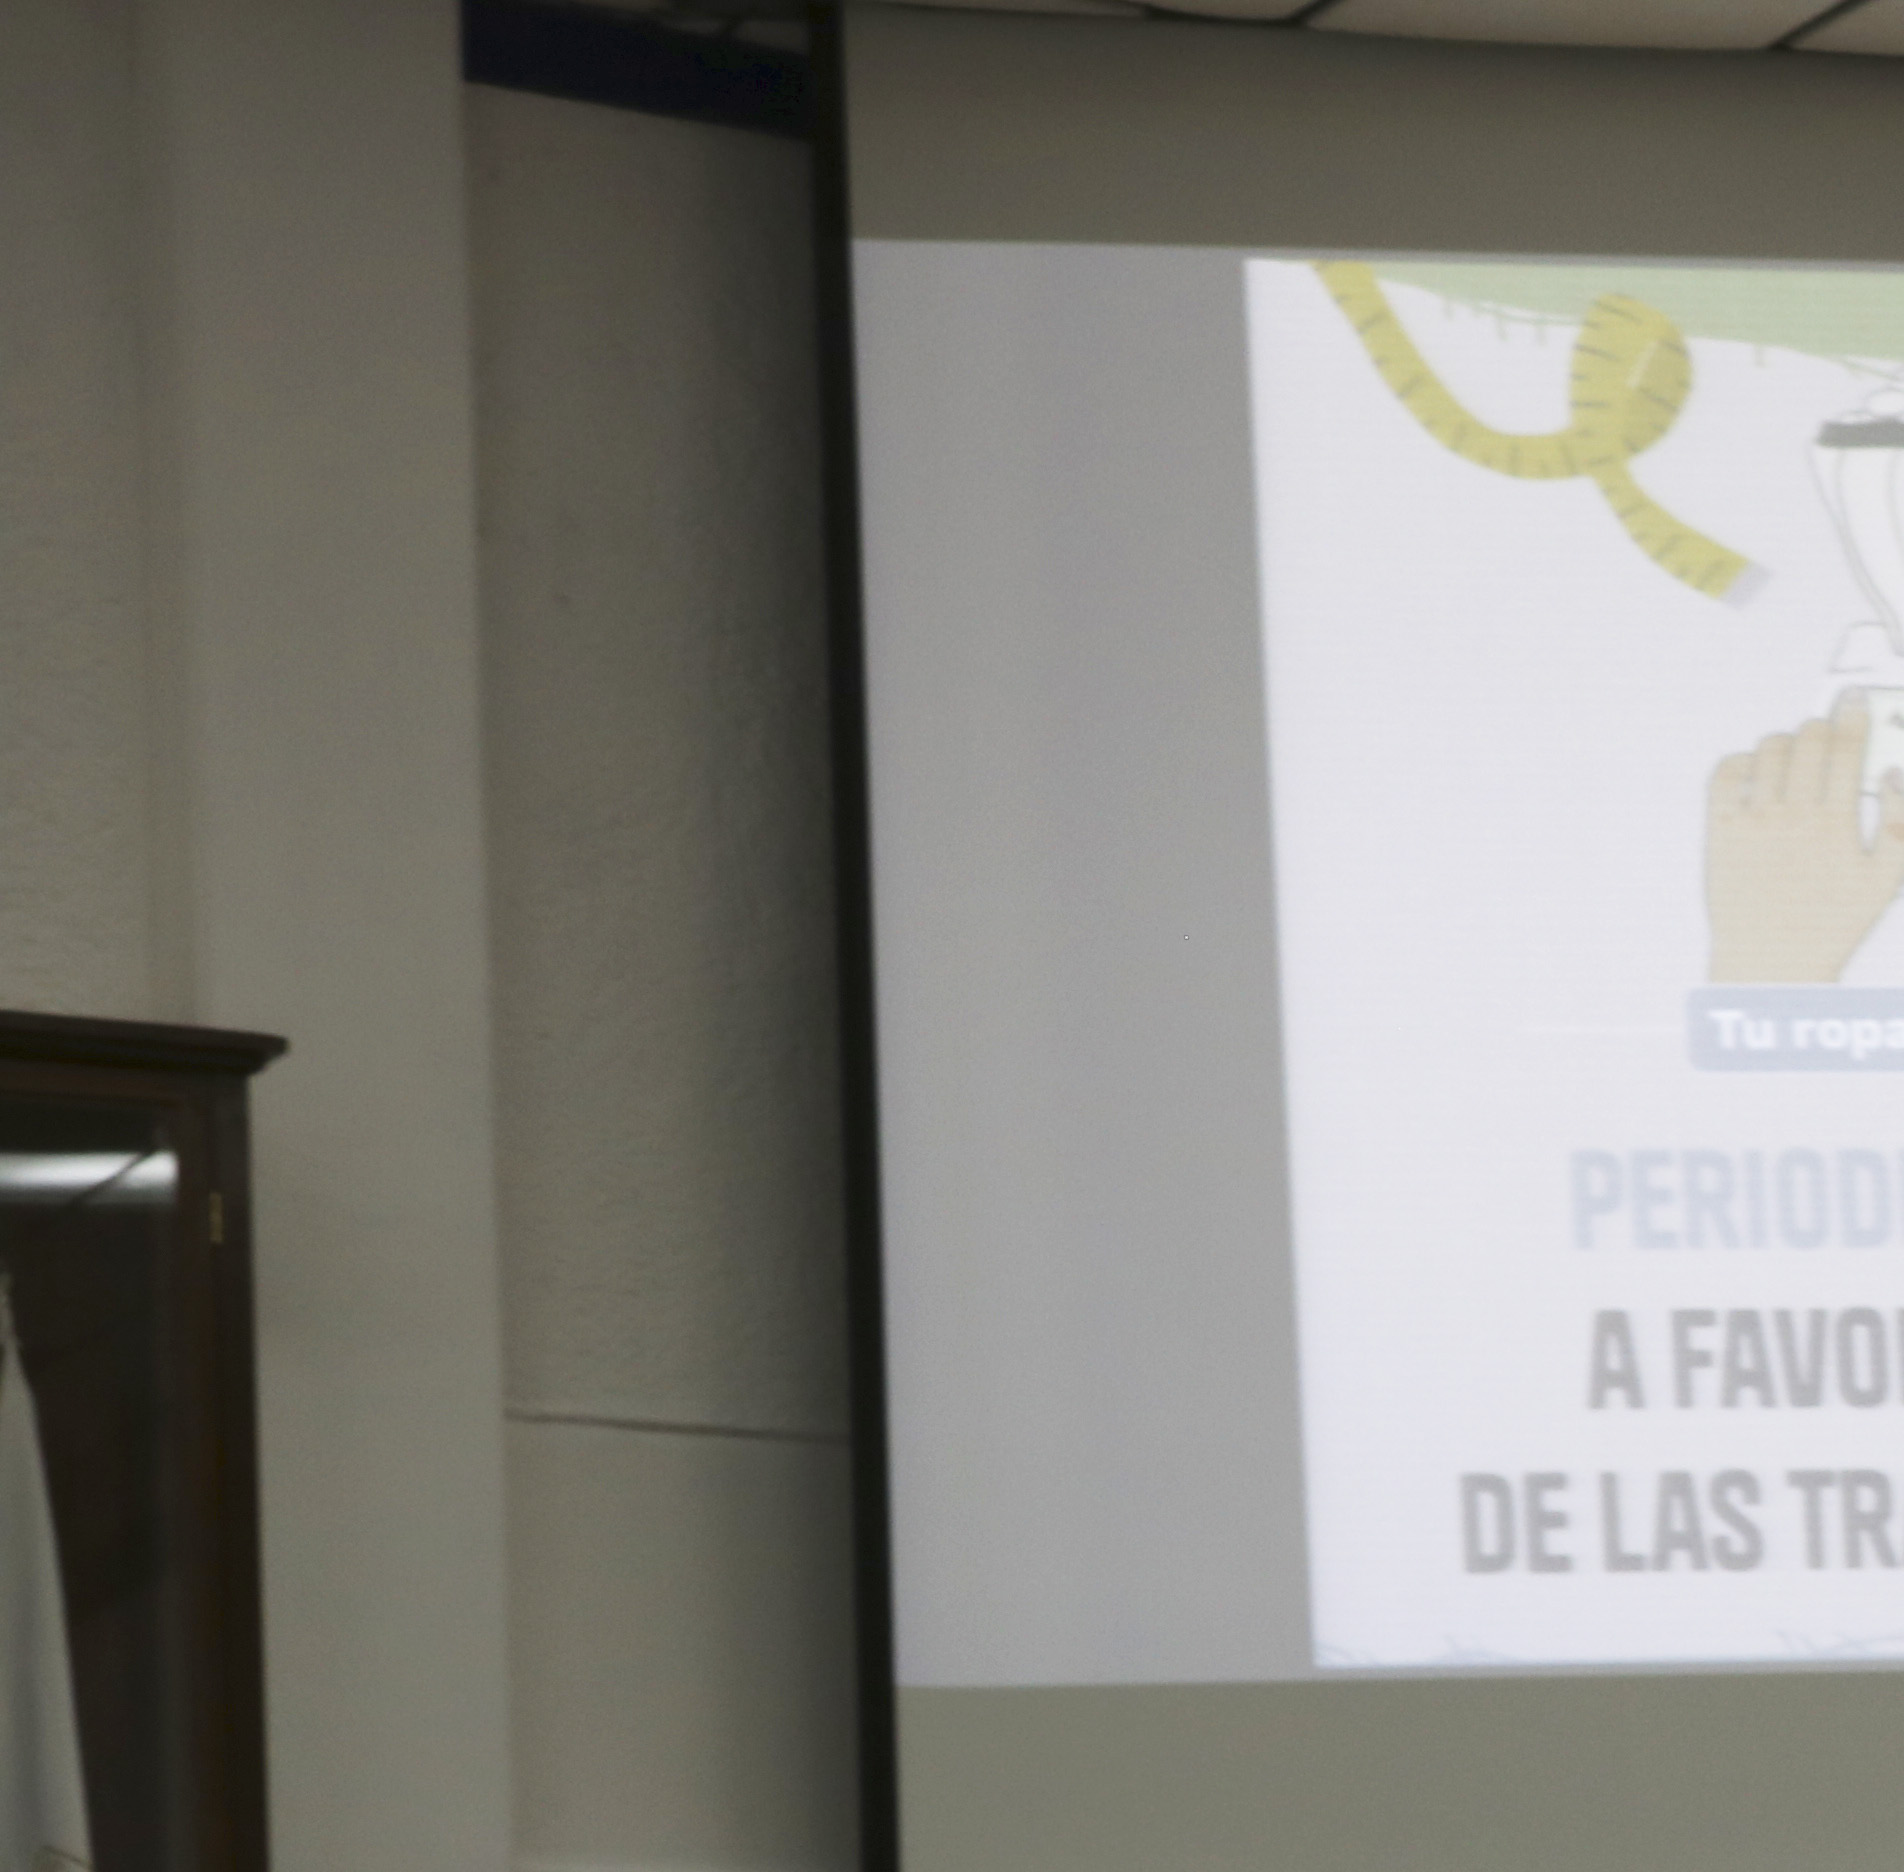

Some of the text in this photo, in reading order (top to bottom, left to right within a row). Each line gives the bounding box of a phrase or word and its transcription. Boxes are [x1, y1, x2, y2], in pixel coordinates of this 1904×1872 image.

[1710, 1009, 1776, 1048] Tu
[1589, 1309, 1644, 1408] A
[1461, 1472, 1573, 1573] DE
[1600, 1469, 1763, 1572] LAS
